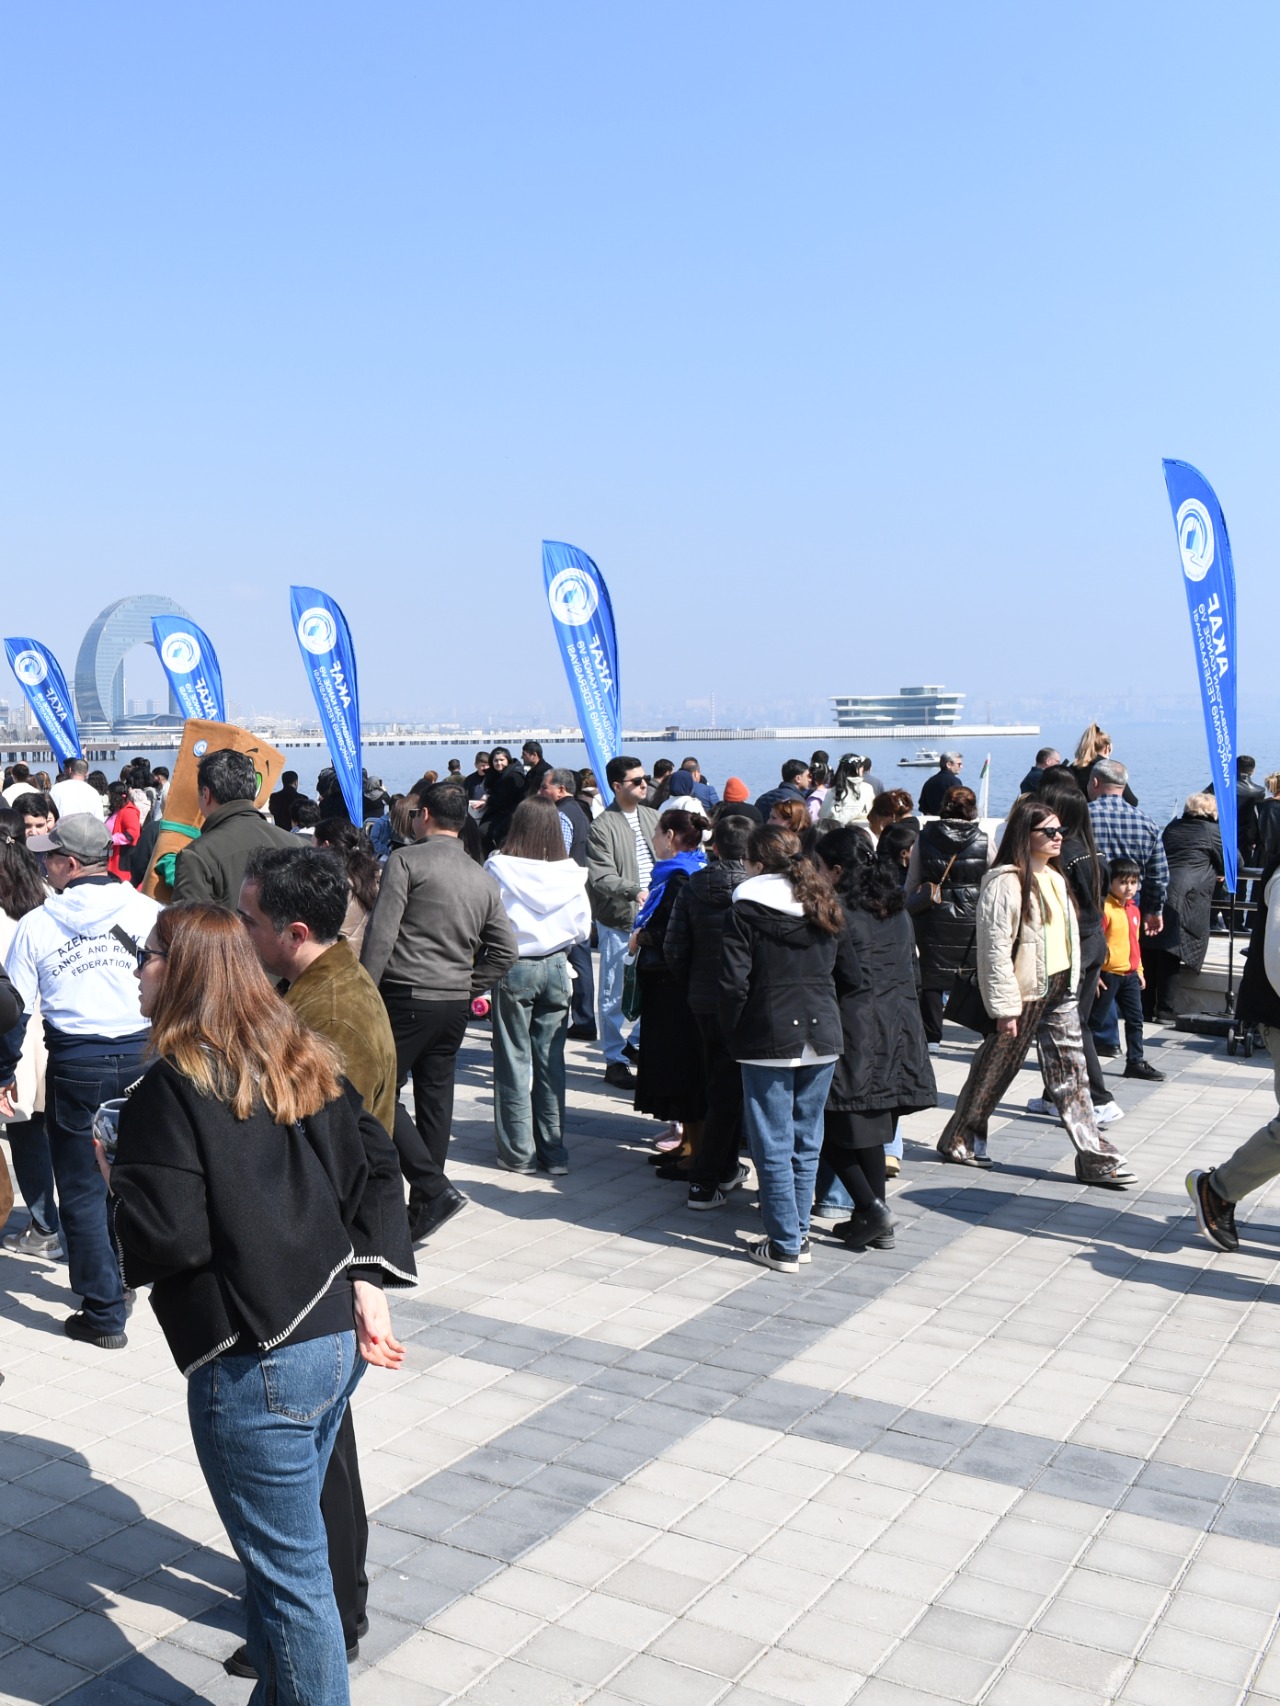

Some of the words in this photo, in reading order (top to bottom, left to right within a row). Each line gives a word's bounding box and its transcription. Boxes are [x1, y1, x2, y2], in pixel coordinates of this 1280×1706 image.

[51, 951, 83, 977] CANOE
[88, 944, 108, 955] AND
[71, 958, 132, 977] FEDERATION
